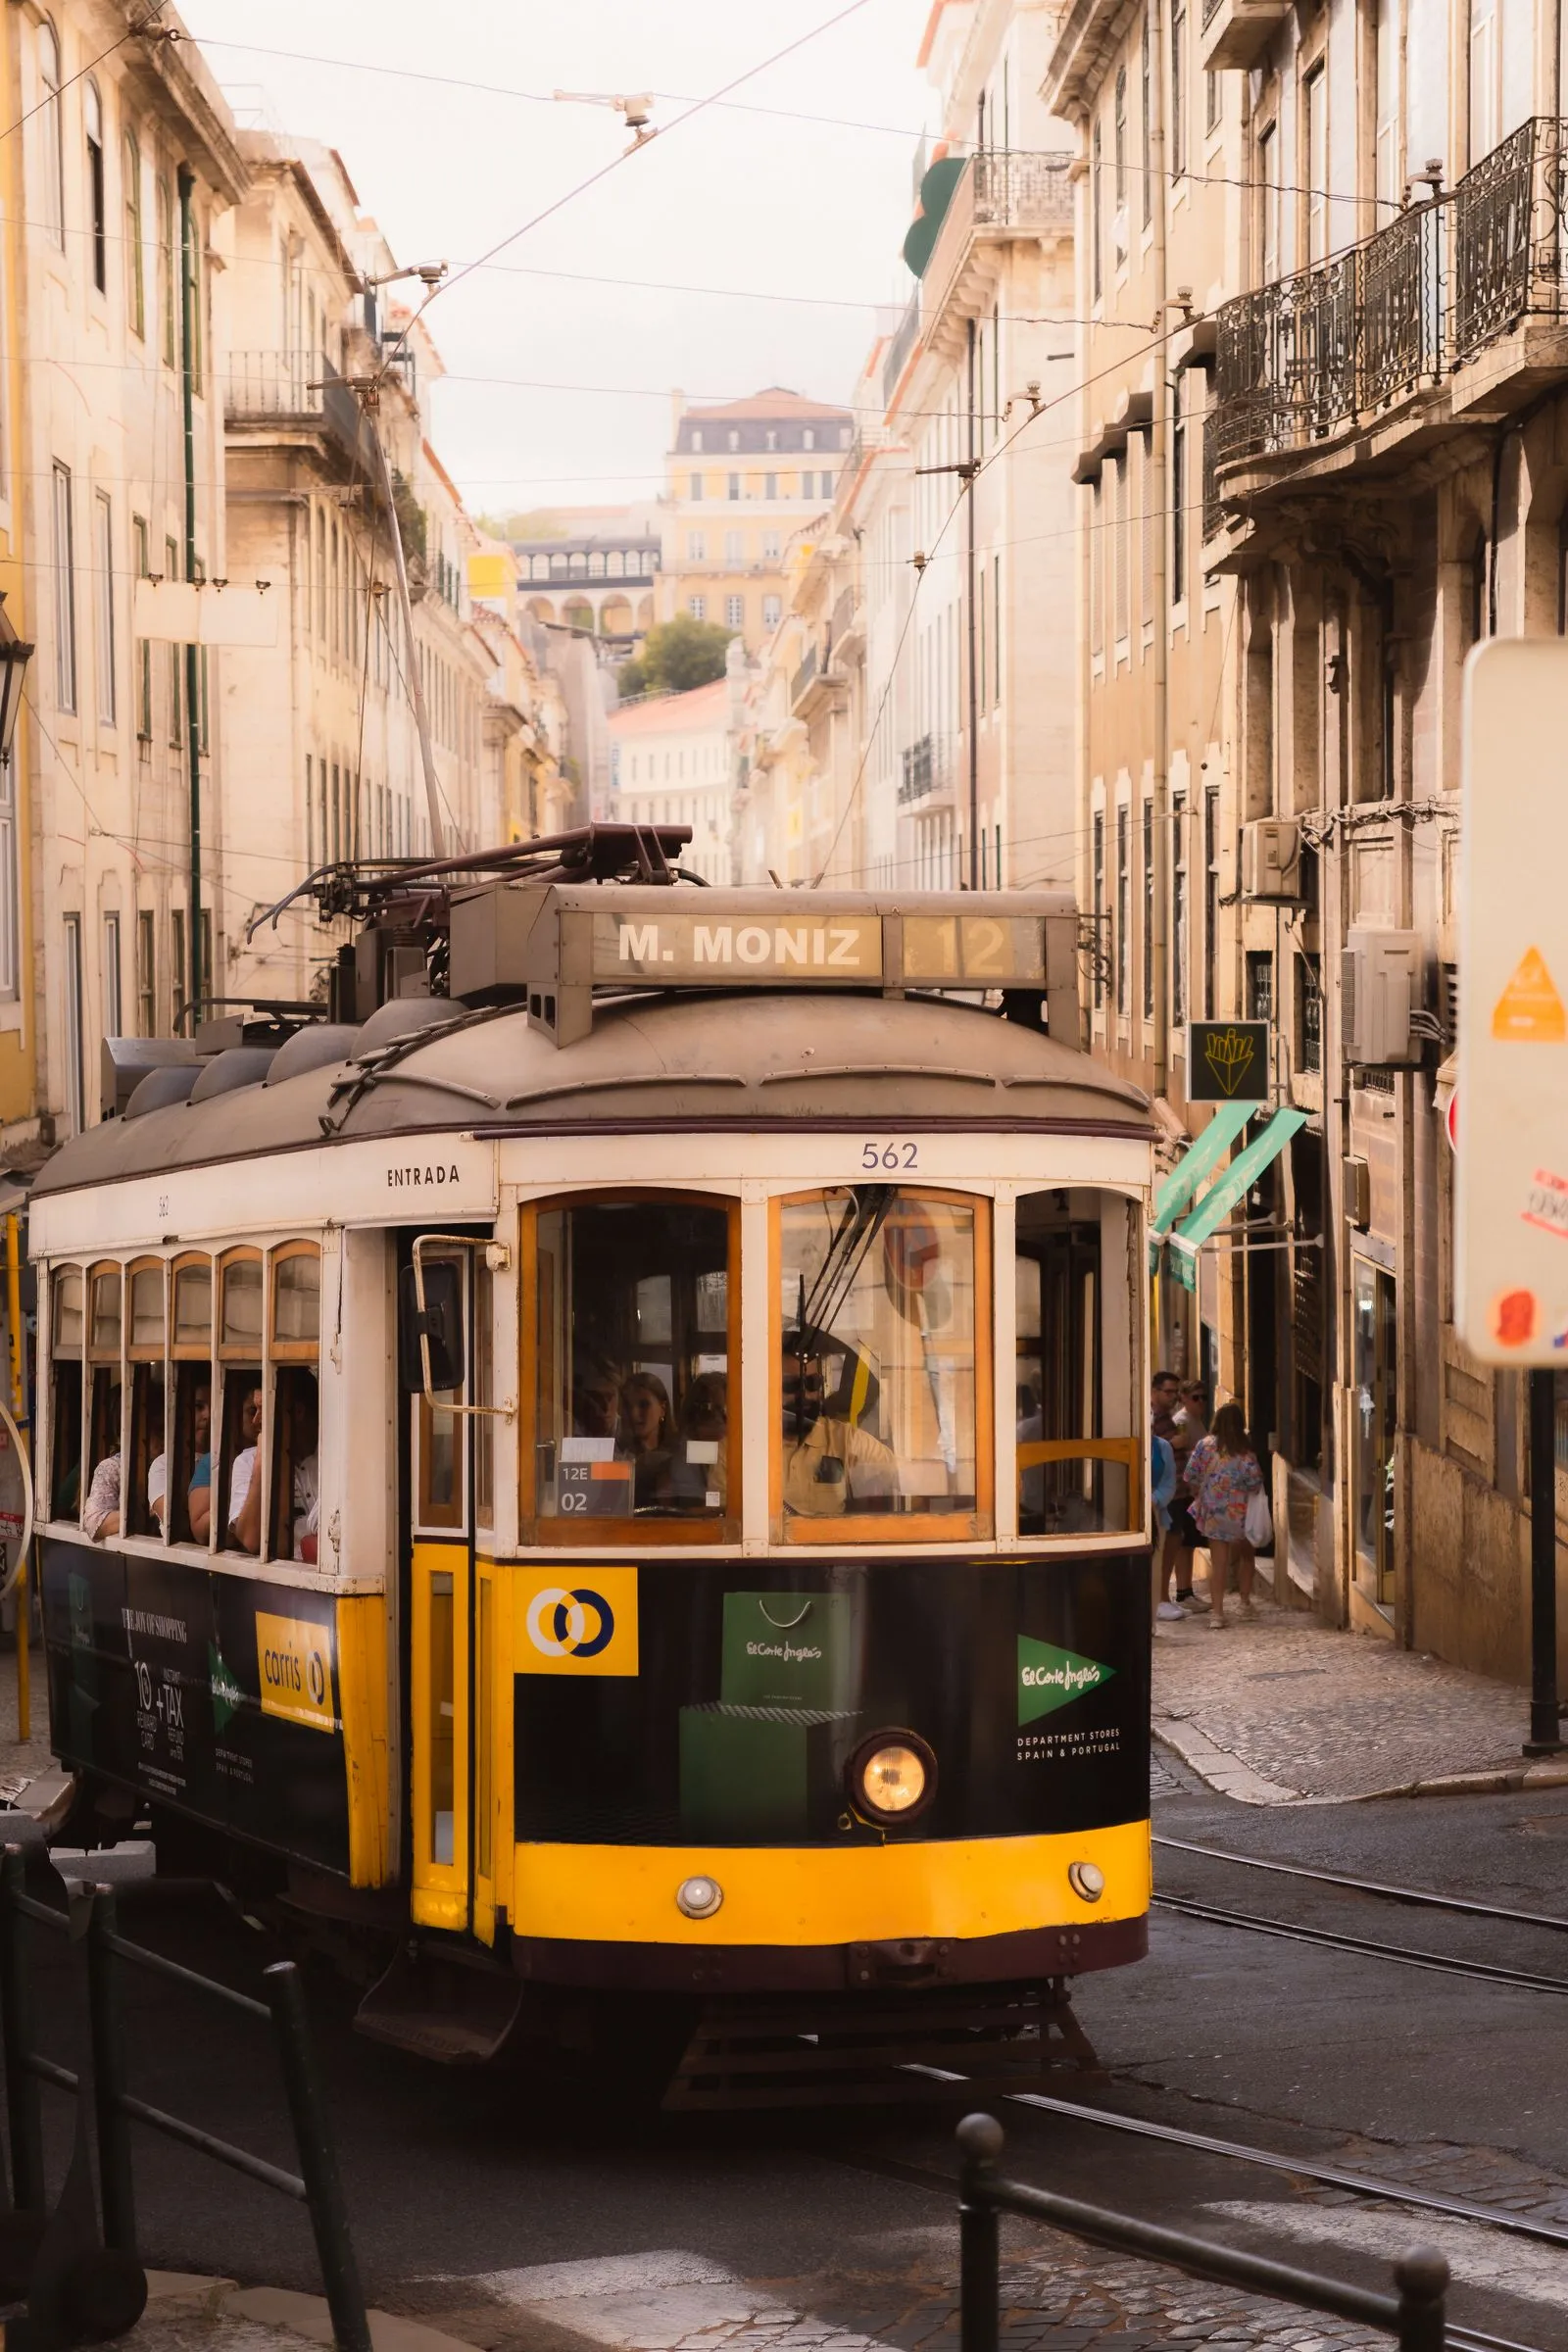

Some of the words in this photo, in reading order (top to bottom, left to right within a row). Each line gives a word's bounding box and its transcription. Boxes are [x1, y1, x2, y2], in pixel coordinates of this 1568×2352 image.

[618, 924, 674, 961] M.
[693, 926, 860, 966] MONIZ
[936, 920, 1005, 974] 12
[861, 1142, 918, 1169] 562
[387, 1164, 460, 1187] ENTRADA
[563, 1467, 588, 1481] 12E
[561, 1493, 588, 1511] 02
[155, 1614, 187, 1643] SHOPPING
[746, 1642, 758, 1655] El
[758, 1642, 783, 1656] Corte
[783, 1641, 822, 1662] Inglés
[265, 1641, 301, 1692] carris
[1021, 1666, 1036, 1687] El
[1035, 1667, 1065, 1686] Corte
[1063, 1660, 1101, 1690] Inglés
[1017, 1732, 1086, 1747] DEPARTMENT
[1089, 1728, 1120, 1740] STORES
[1017, 1749, 1054, 1761] SPAIN
[1059, 1748, 1065, 1757] &
[1071, 1741, 1120, 1756] PORTUGAL
